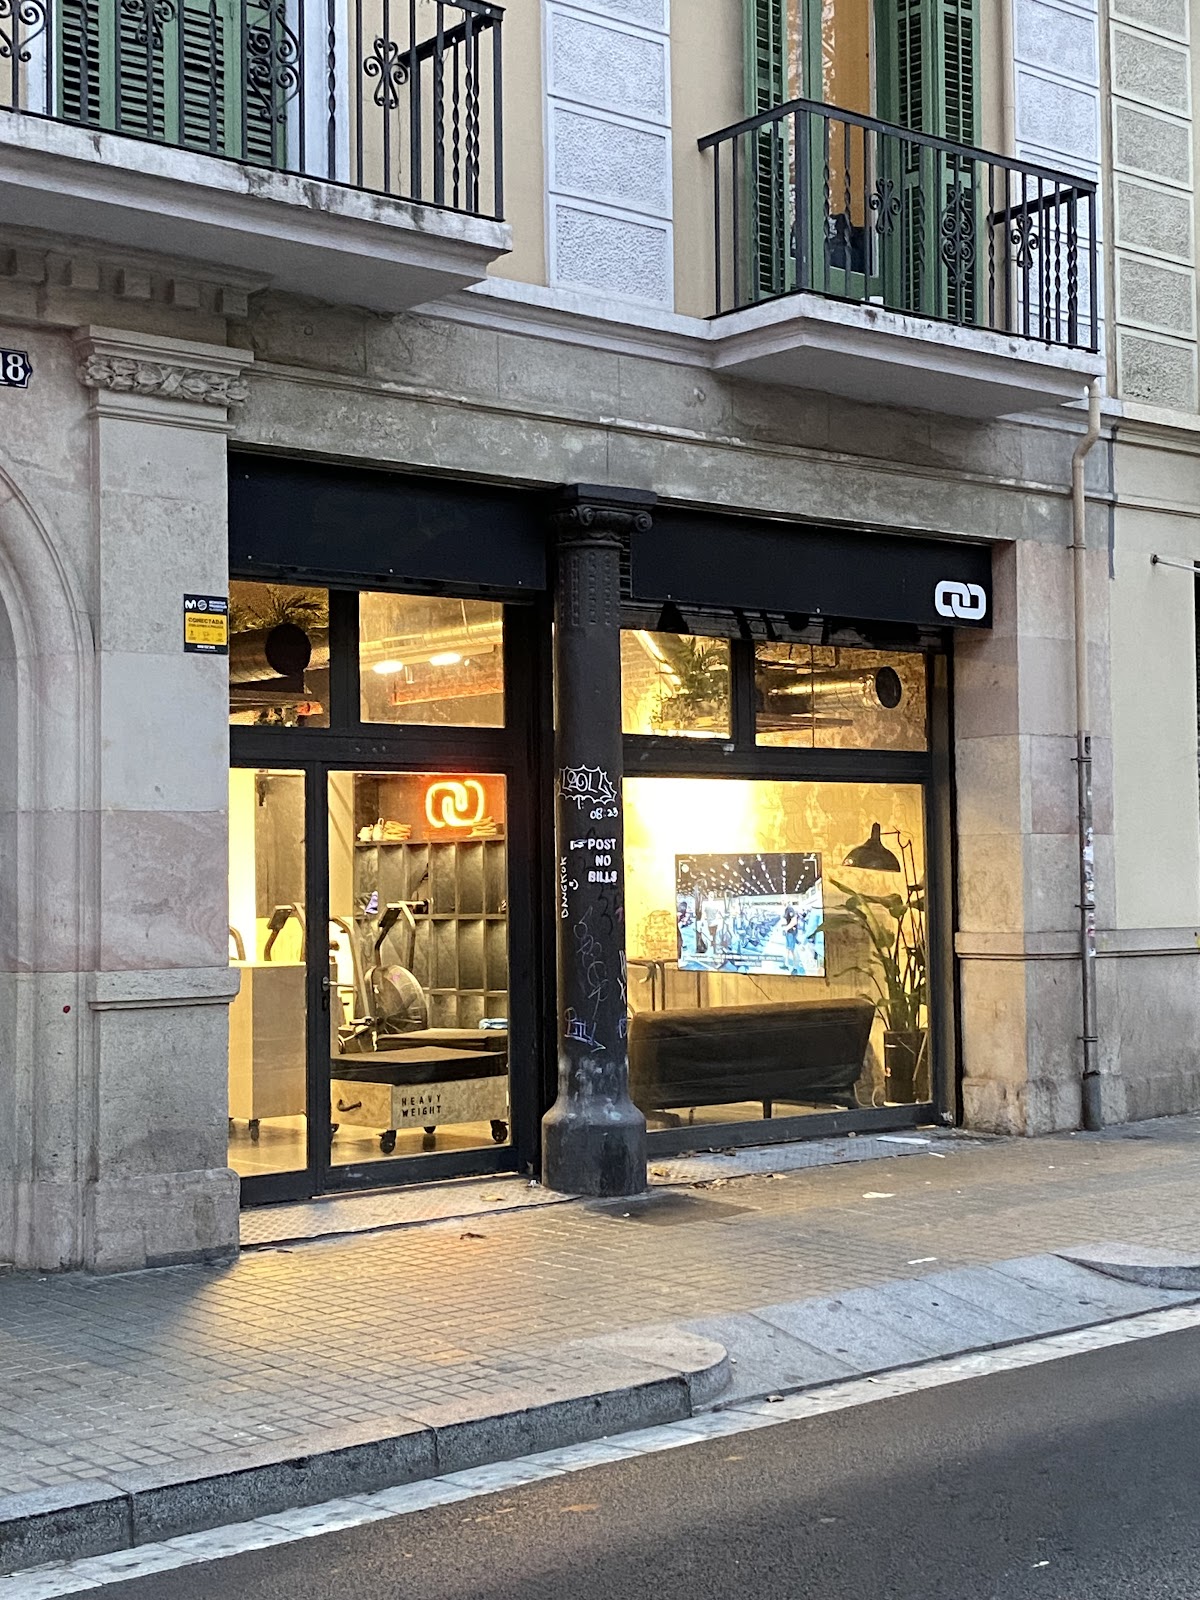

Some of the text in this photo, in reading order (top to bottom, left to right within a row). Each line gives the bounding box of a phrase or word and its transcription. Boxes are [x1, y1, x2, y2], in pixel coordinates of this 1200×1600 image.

[587, 838, 617, 850] POST
[595, 855, 611, 867] NO
[587, 870, 618, 883] BILLS
[401, 1094, 441, 1107] HEAVY
[401, 1105, 441, 1117] WEIGHT
